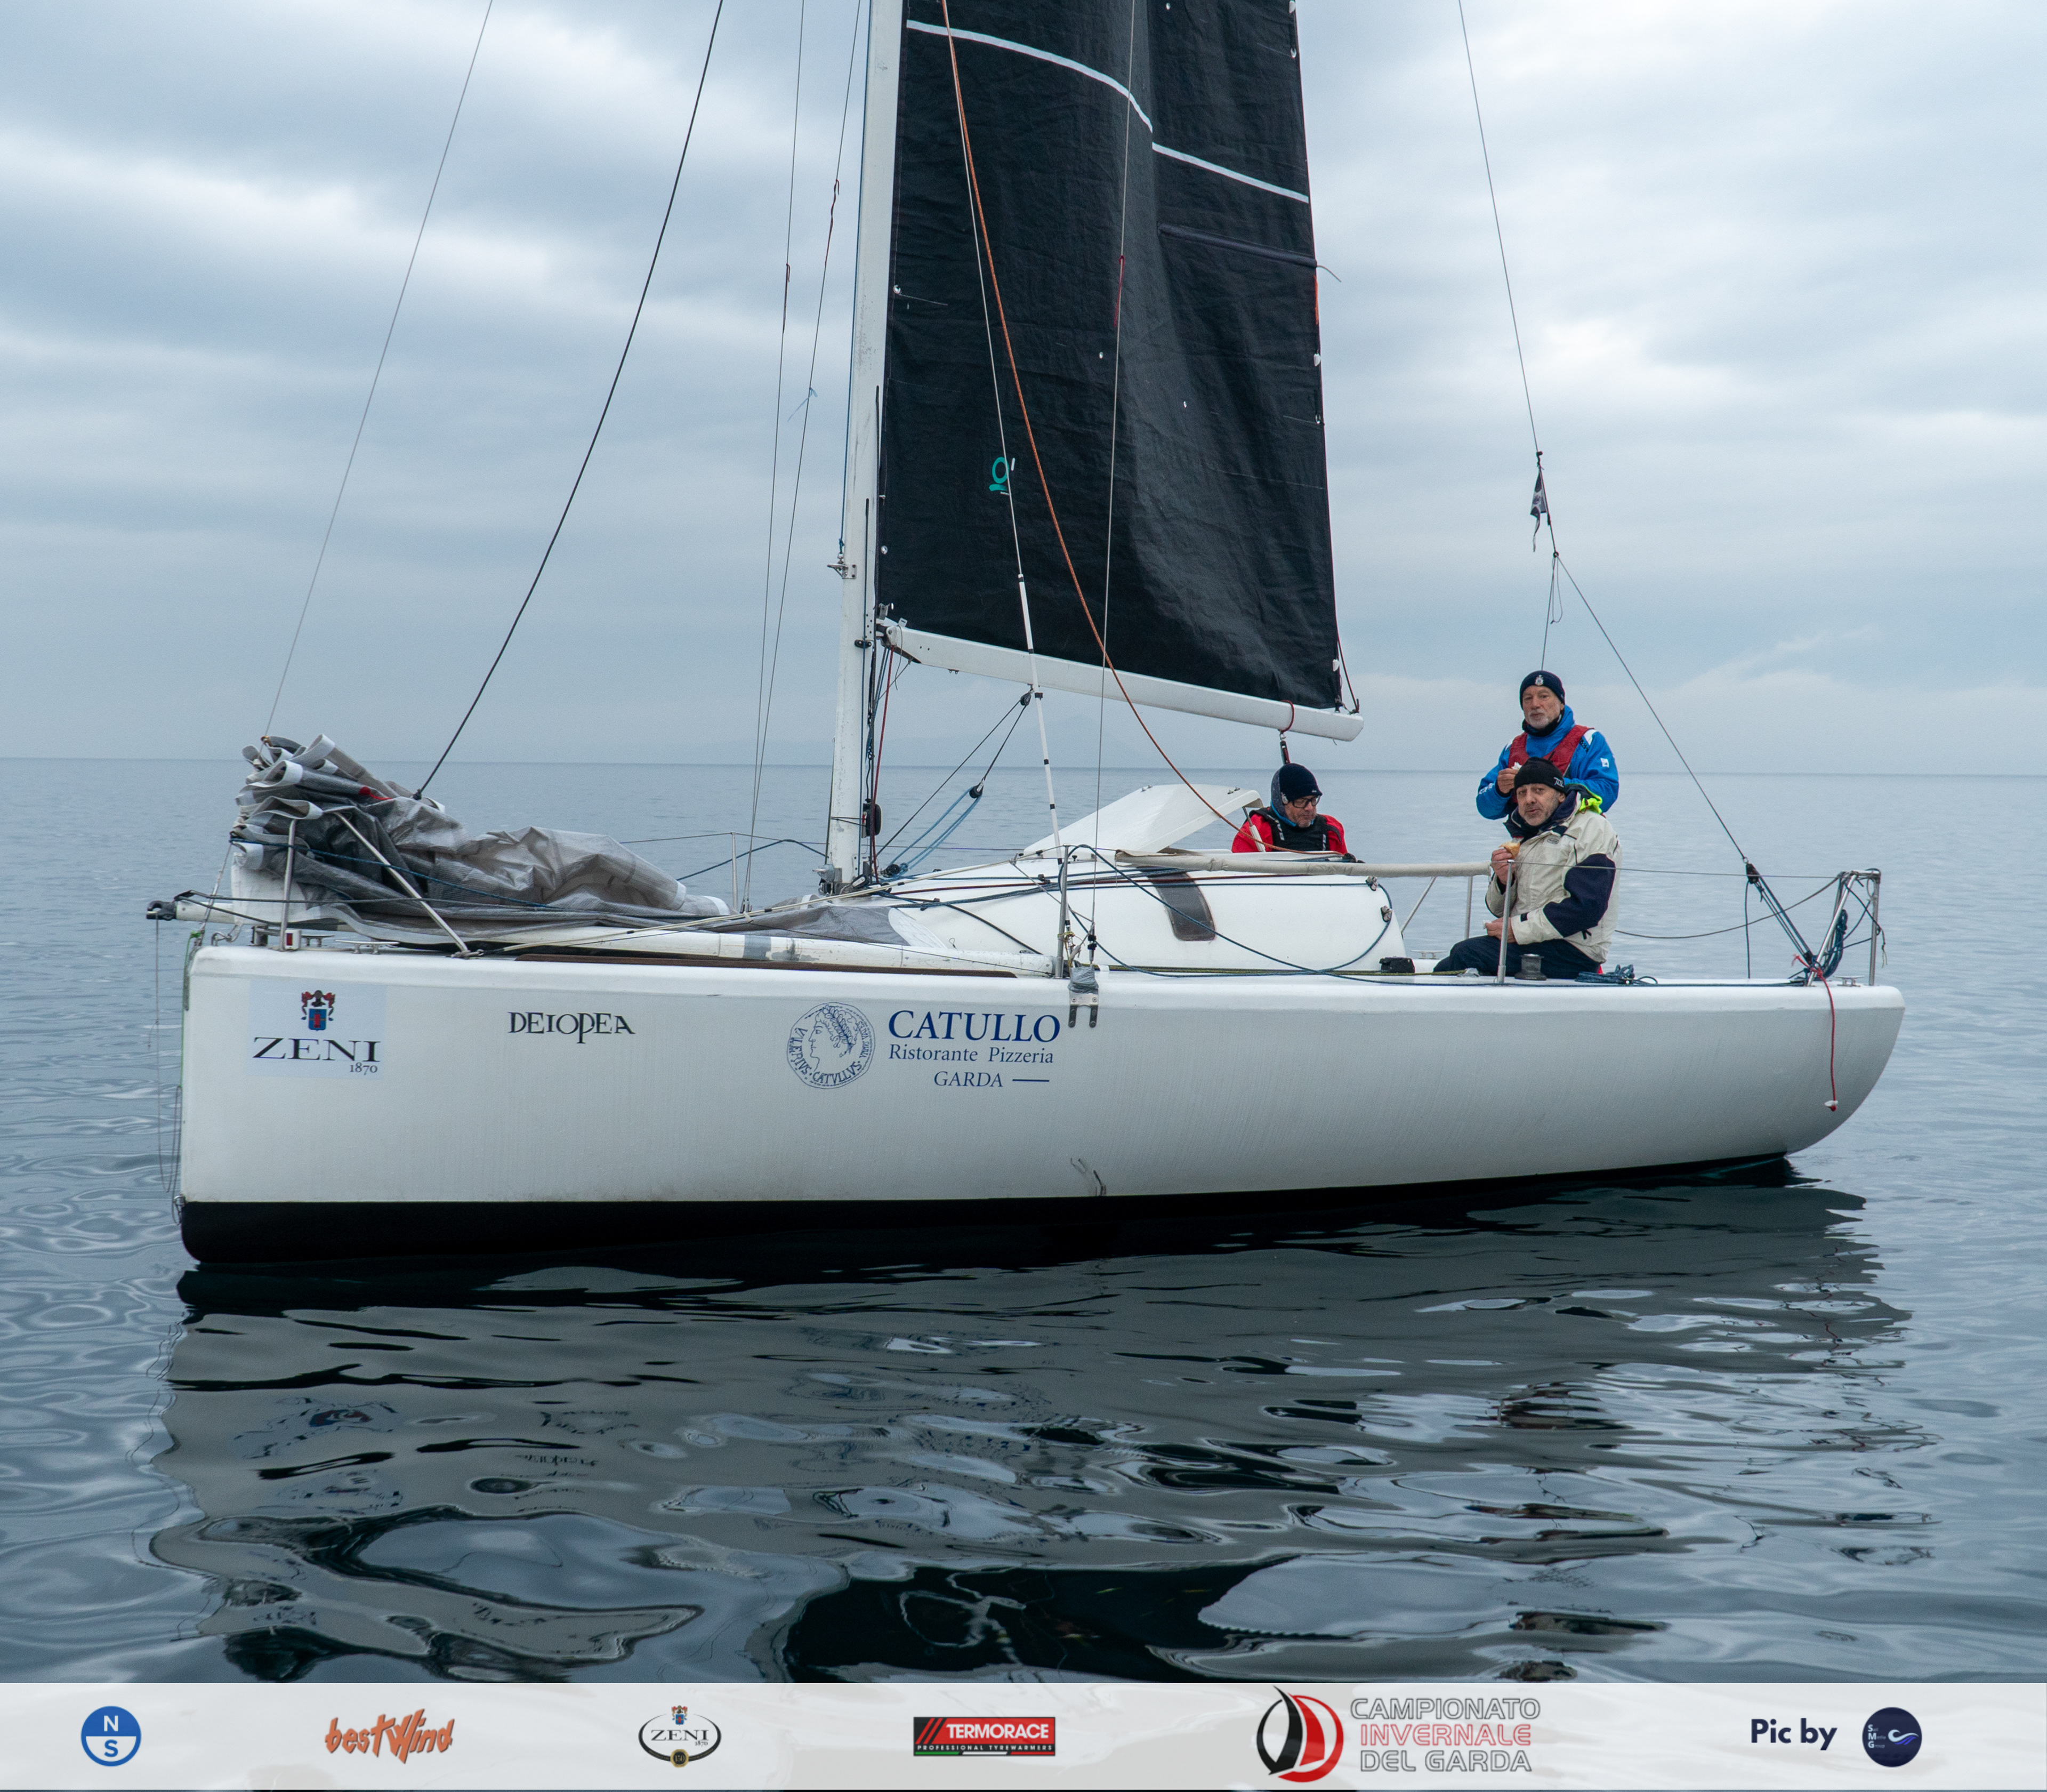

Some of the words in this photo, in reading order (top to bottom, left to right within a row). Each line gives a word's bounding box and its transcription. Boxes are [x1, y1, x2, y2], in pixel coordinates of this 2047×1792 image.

[507, 1011, 635, 1044] DEIOPEA
[889, 1010, 1060, 1042] CATULLO
[252, 1037, 381, 1062] ZENI
[889, 1044, 978, 1062] Ristorante
[988, 1047, 1054, 1063] Pizzeria
[350, 1062, 377, 1075] 1870
[812, 1061, 862, 1084] CATVLLVS
[934, 1071, 1003, 1087] GARDA
